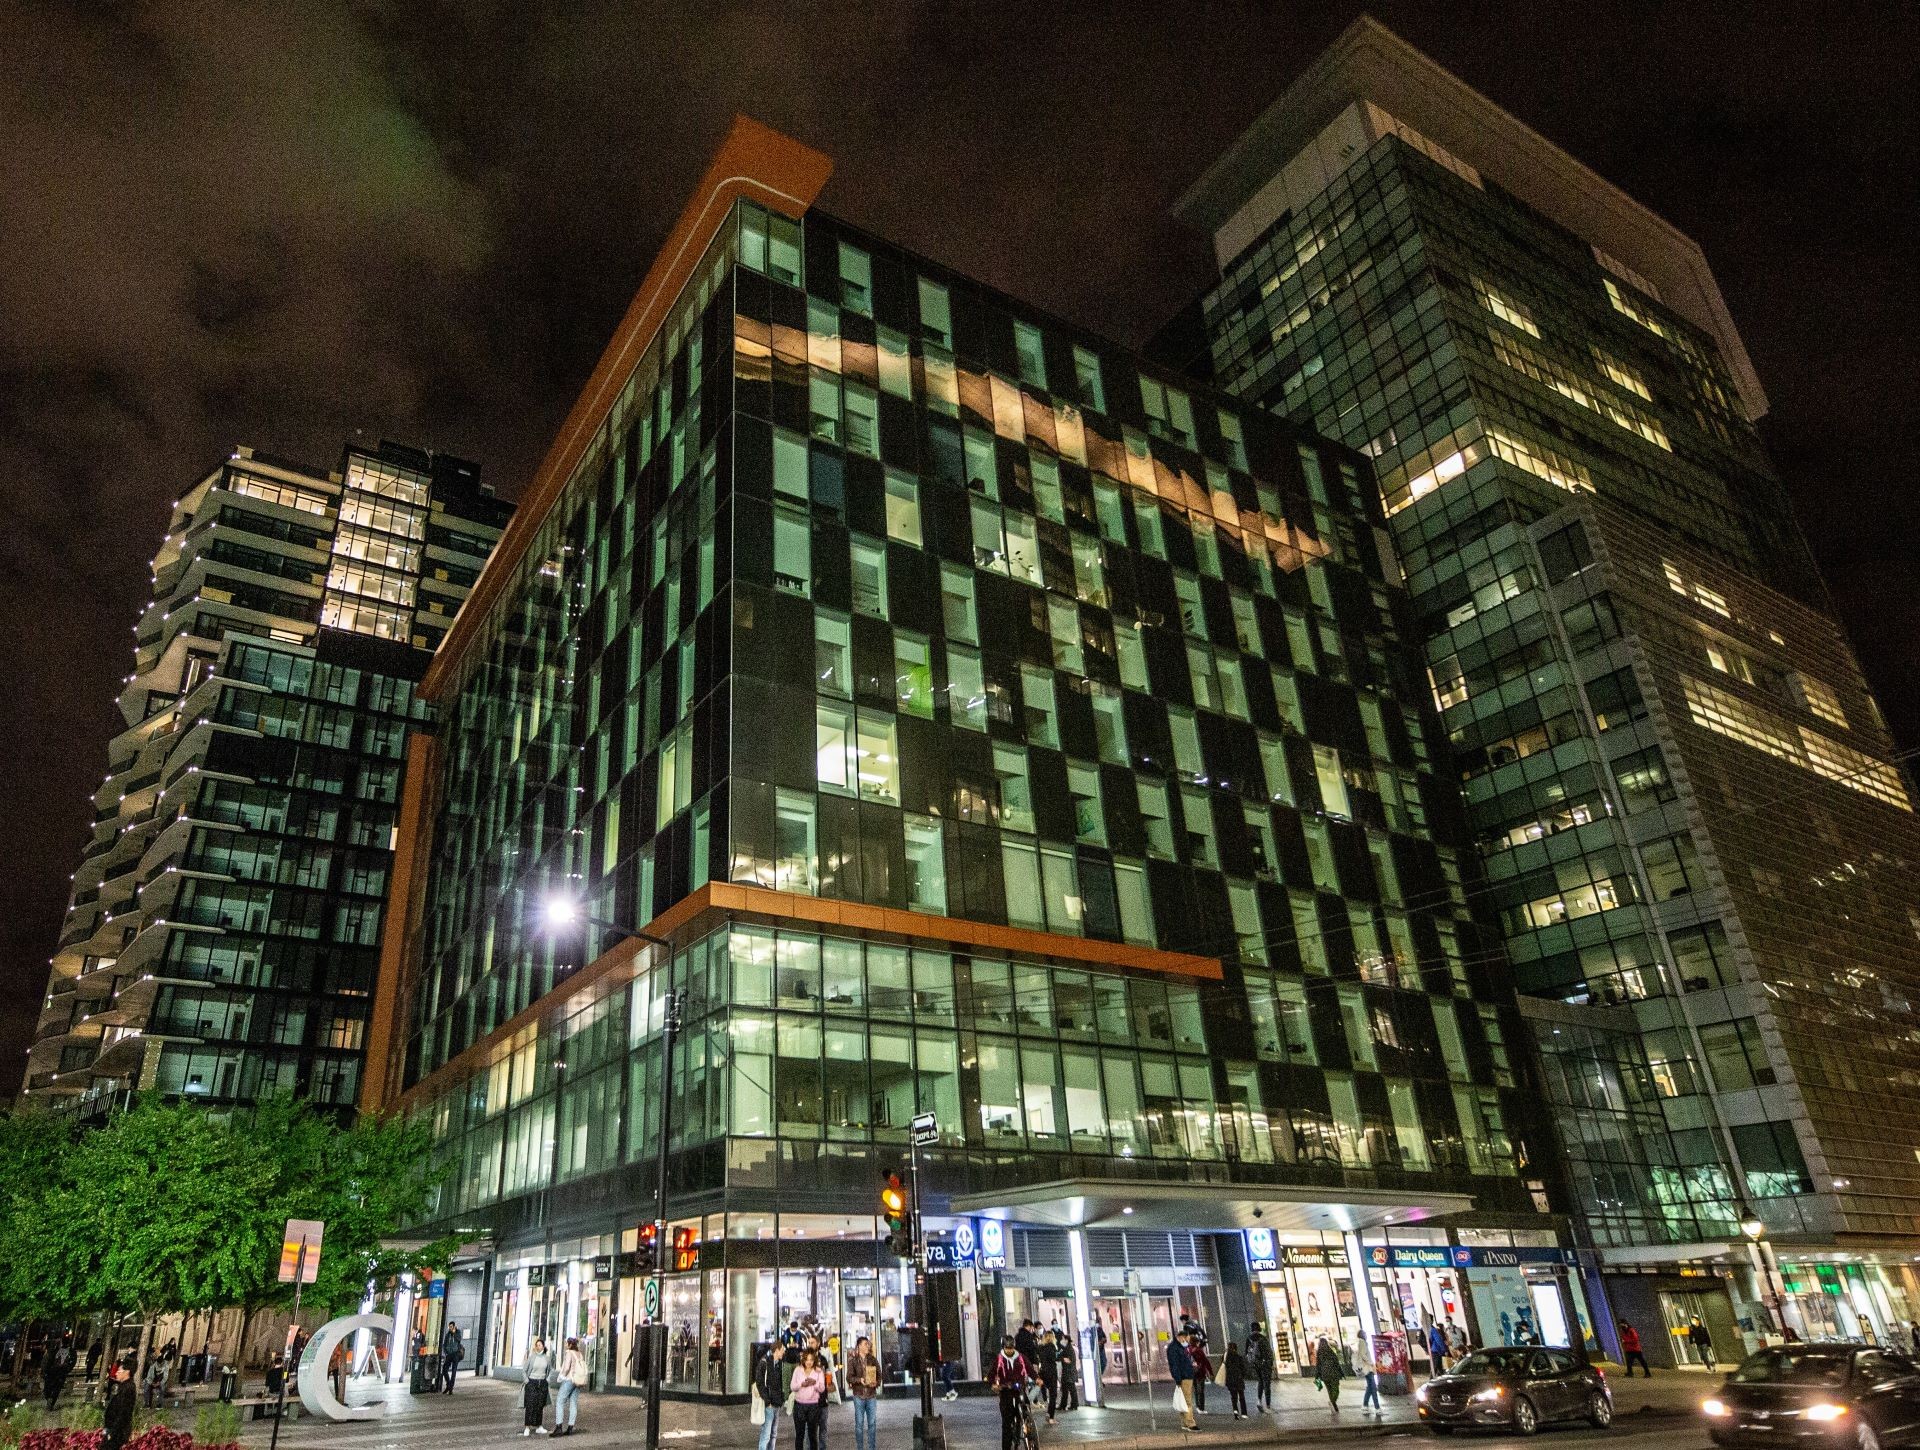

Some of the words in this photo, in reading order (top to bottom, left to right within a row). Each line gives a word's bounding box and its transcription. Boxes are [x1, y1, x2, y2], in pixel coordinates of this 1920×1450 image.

[983, 1256, 1005, 1268] METRO
[1282, 1248, 1324, 1264] Nanami
[1395, 1250, 1417, 1263] Dairy
[1419, 1250, 1444, 1263] Queen
[1488, 1251, 1517, 1264] PANINO
[1252, 1260, 1276, 1270] METRO
